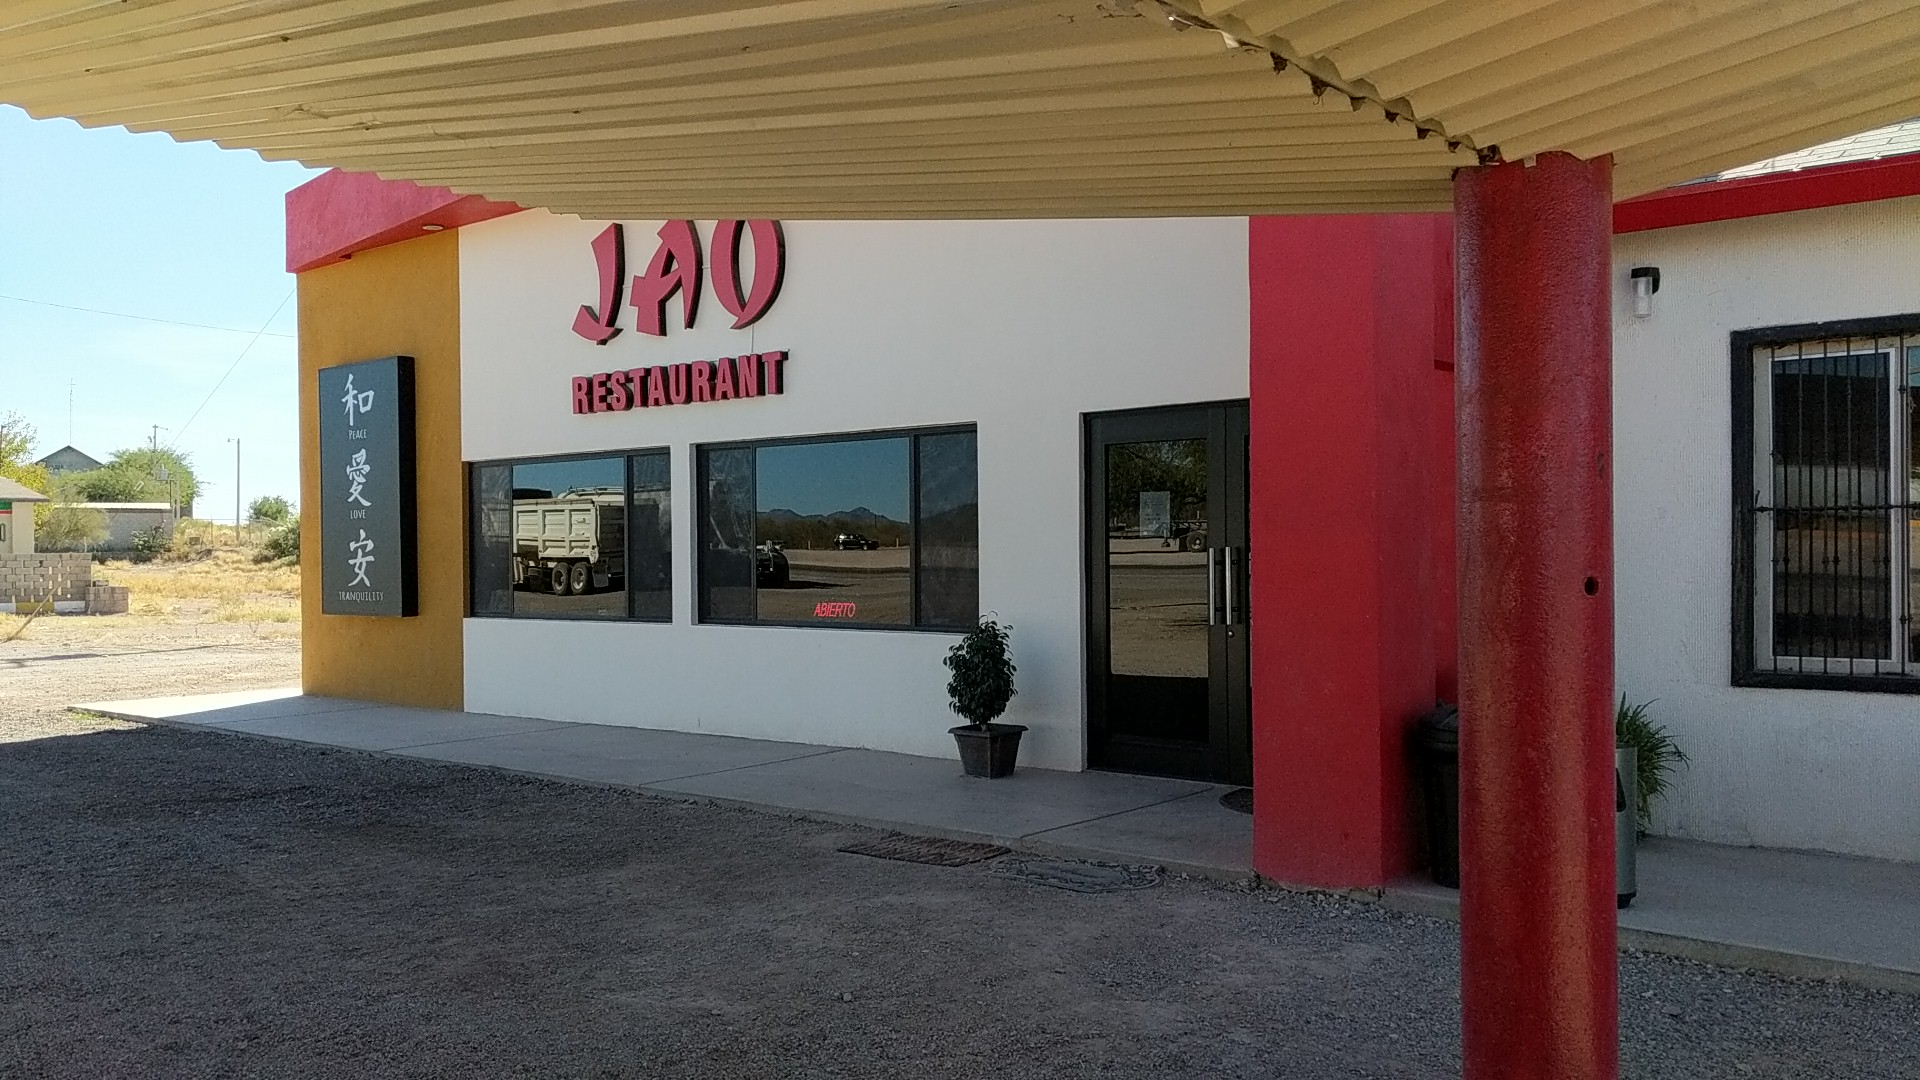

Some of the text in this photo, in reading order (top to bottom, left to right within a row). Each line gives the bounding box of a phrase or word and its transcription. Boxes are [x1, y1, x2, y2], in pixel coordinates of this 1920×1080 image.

[572, 219, 786, 346] JAO
[341, 373, 375, 426] 和
[572, 352, 789, 414] RESTAURANT
[348, 428, 368, 440] PEACE
[346, 448, 372, 507] 愛
[350, 509, 366, 519] LOVE
[347, 529, 375, 587] 安
[338, 591, 384, 602] TRANQUILITY
[813, 602, 856, 617] ABIERTO
